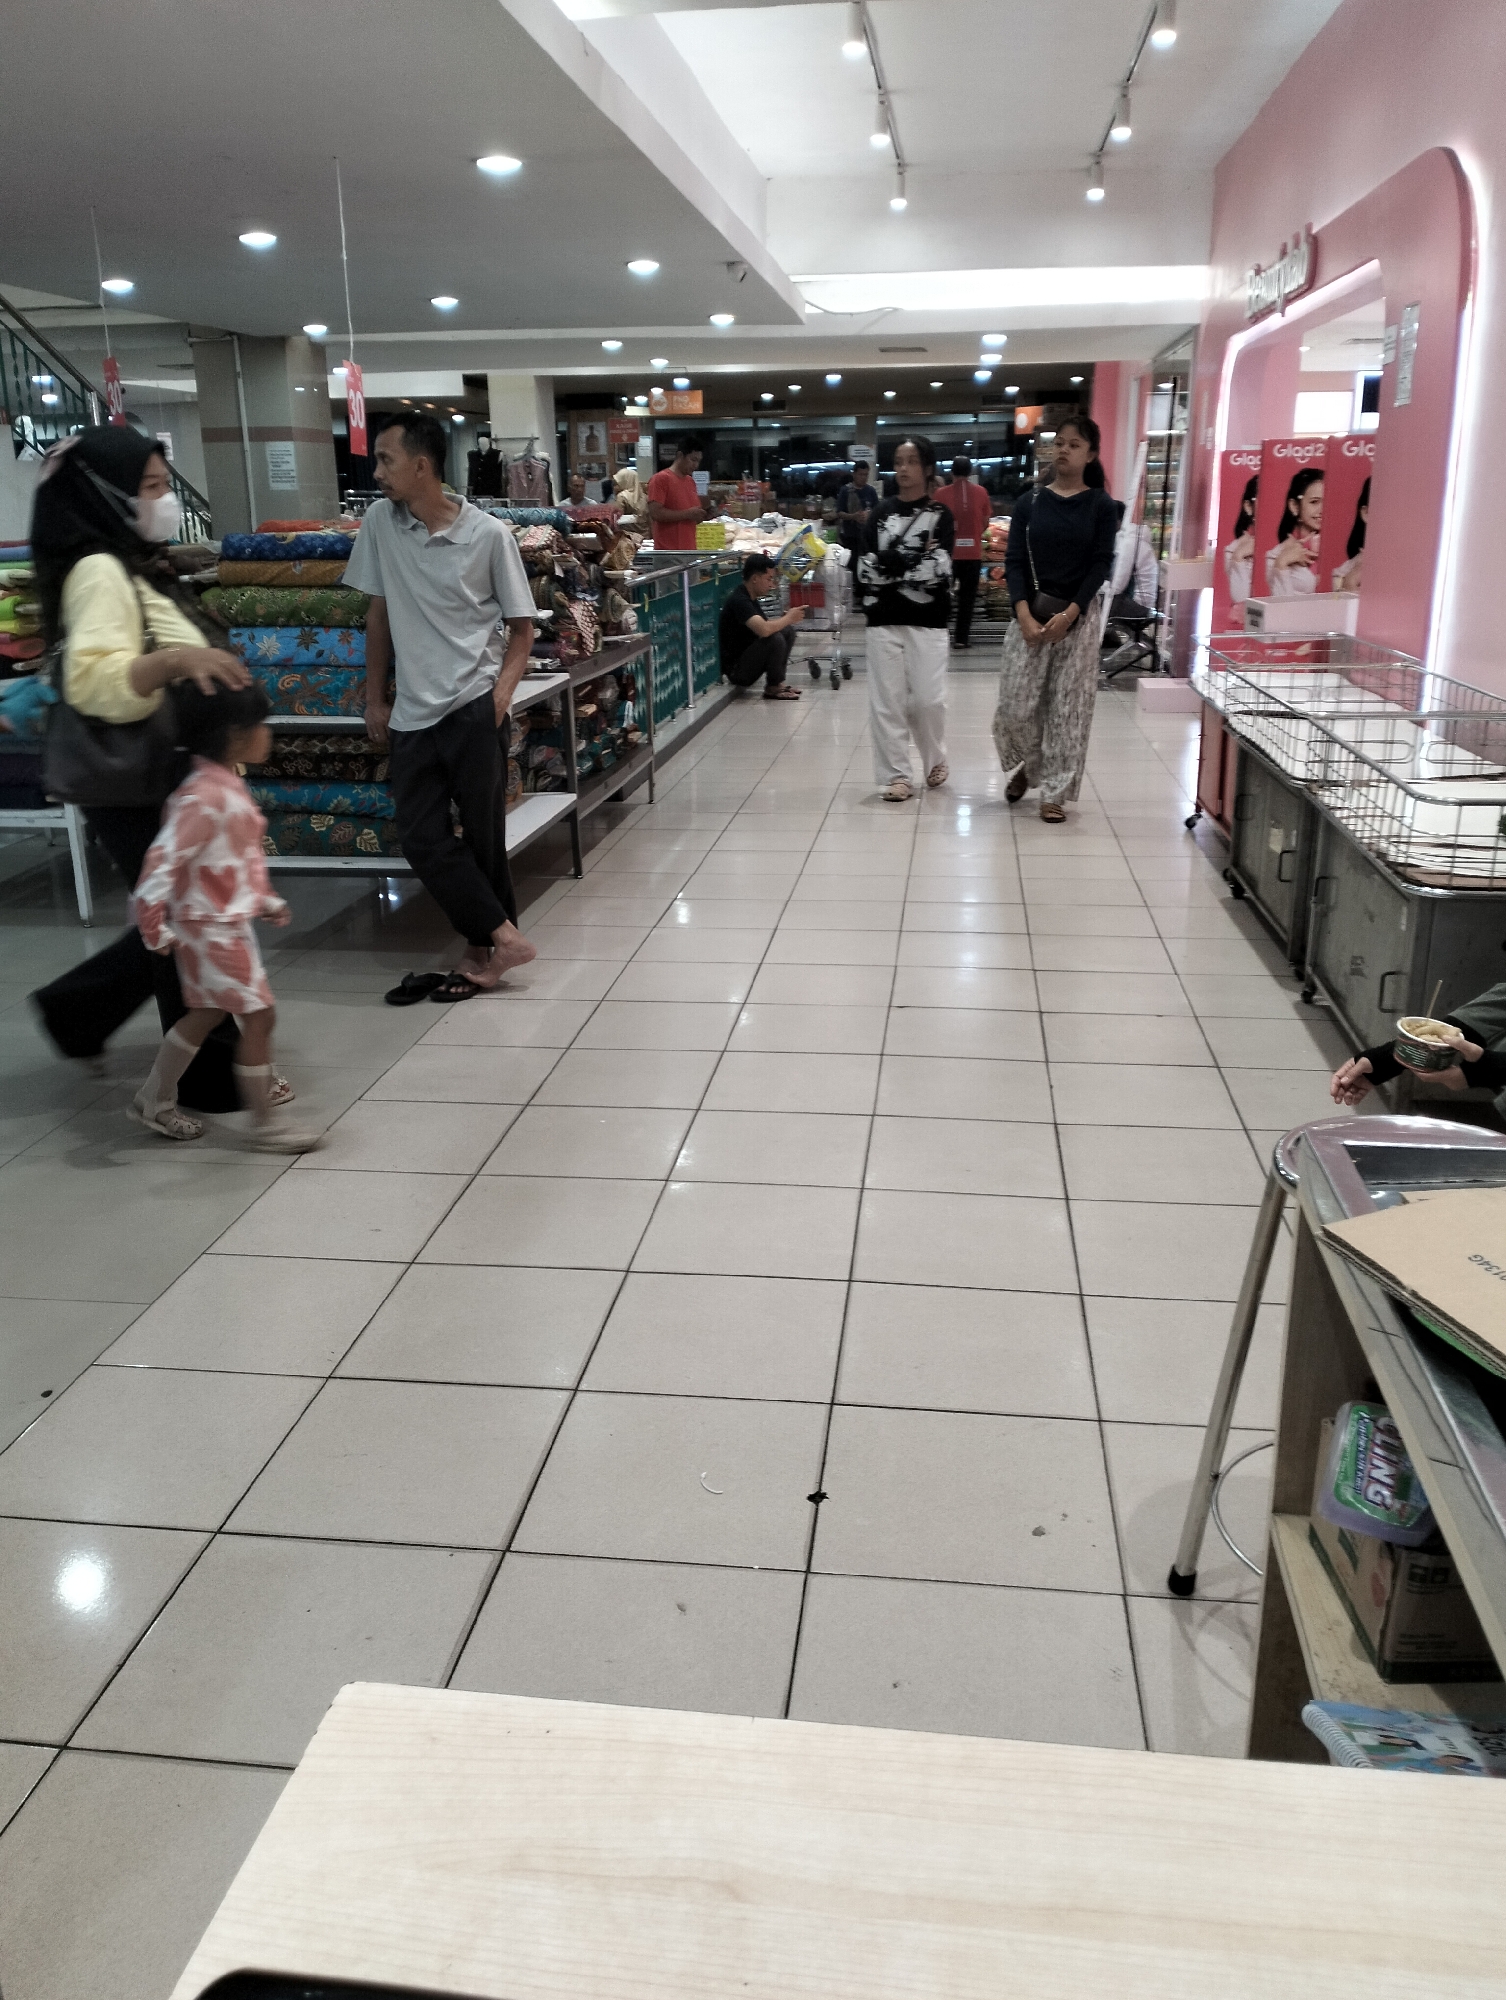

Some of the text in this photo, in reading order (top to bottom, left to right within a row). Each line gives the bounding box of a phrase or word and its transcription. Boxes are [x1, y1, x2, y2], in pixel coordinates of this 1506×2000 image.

[107, 380, 123, 415] 30
[348, 389, 365, 429] 30
[1364, 1416, 1402, 1511] CLING
